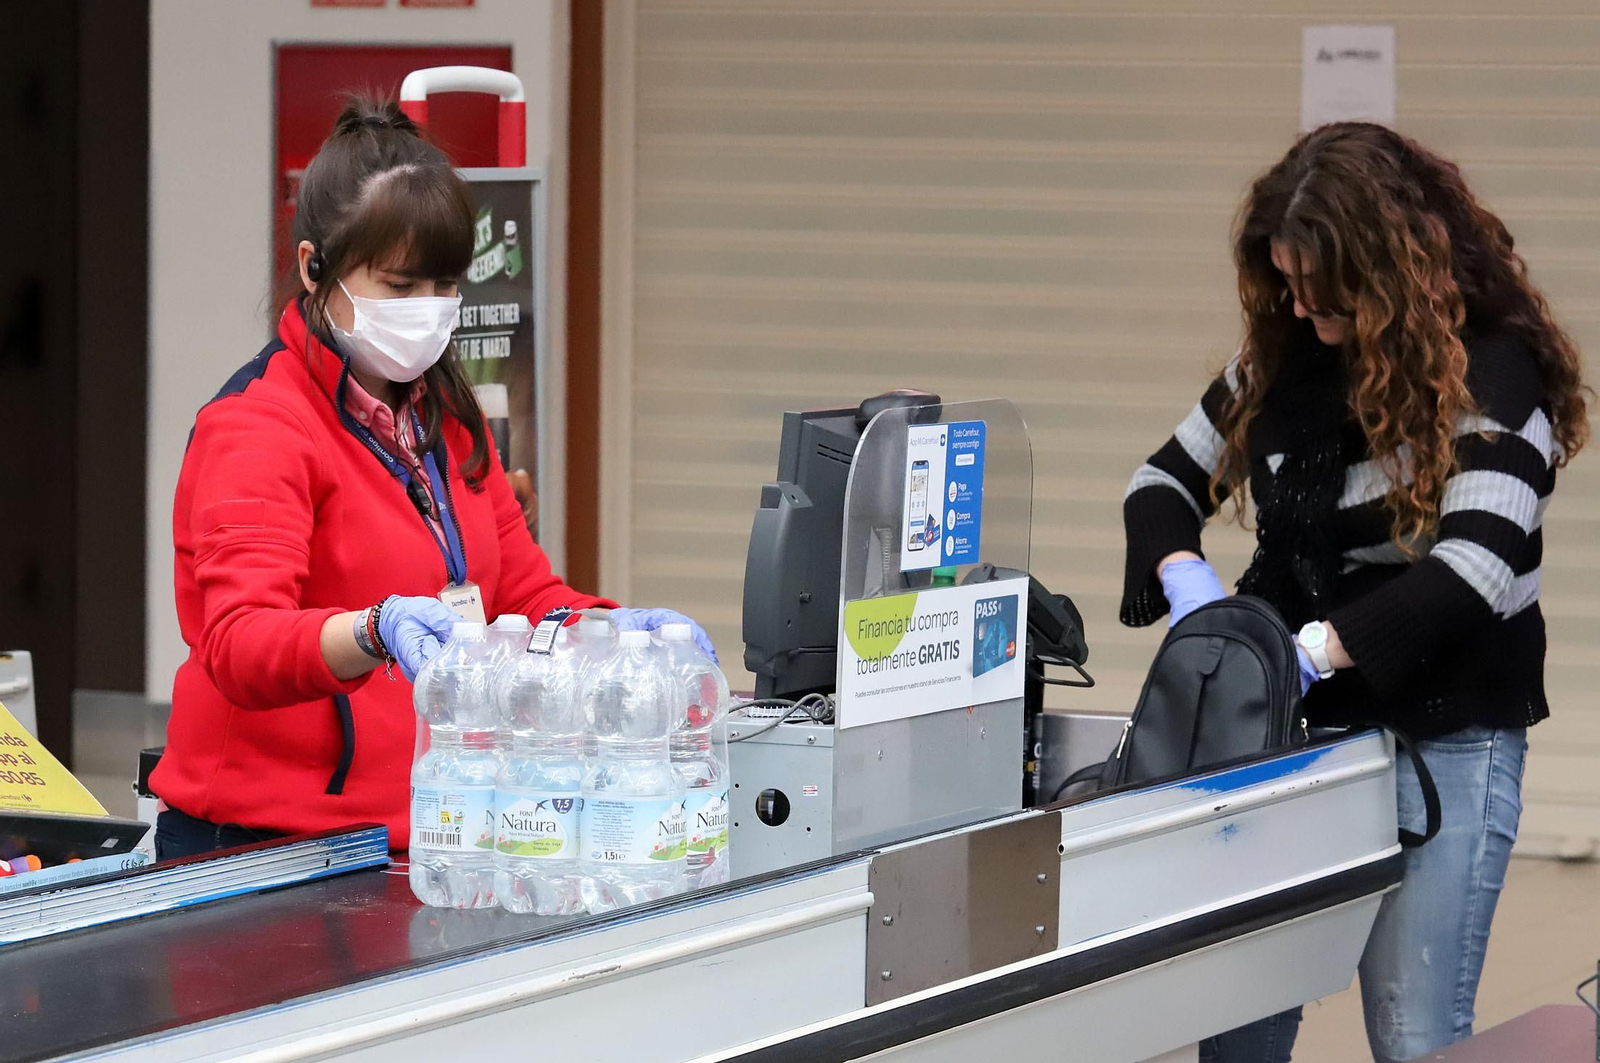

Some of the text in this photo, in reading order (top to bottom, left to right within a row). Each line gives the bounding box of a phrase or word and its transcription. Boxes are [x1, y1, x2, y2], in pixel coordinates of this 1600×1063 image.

[462, 306, 478, 328] GET
[479, 303, 520, 327] TOGETHER
[470, 338, 481, 360] DE
[482, 336, 511, 359] MARZO
[368, 436, 394, 463] contigo
[958, 482, 967, 493] Paga
[956, 512, 971, 523] Compra
[955, 537, 967, 546] Ahorra
[975, 601, 998, 619] PASS
[858, 610, 959, 640] Financia tu compra
[857, 640, 960, 676] totalmente GRATIS
[18, 751, 36, 765] al
[556, 800, 569, 809] 1,5
[501, 813, 556, 832] Natura
